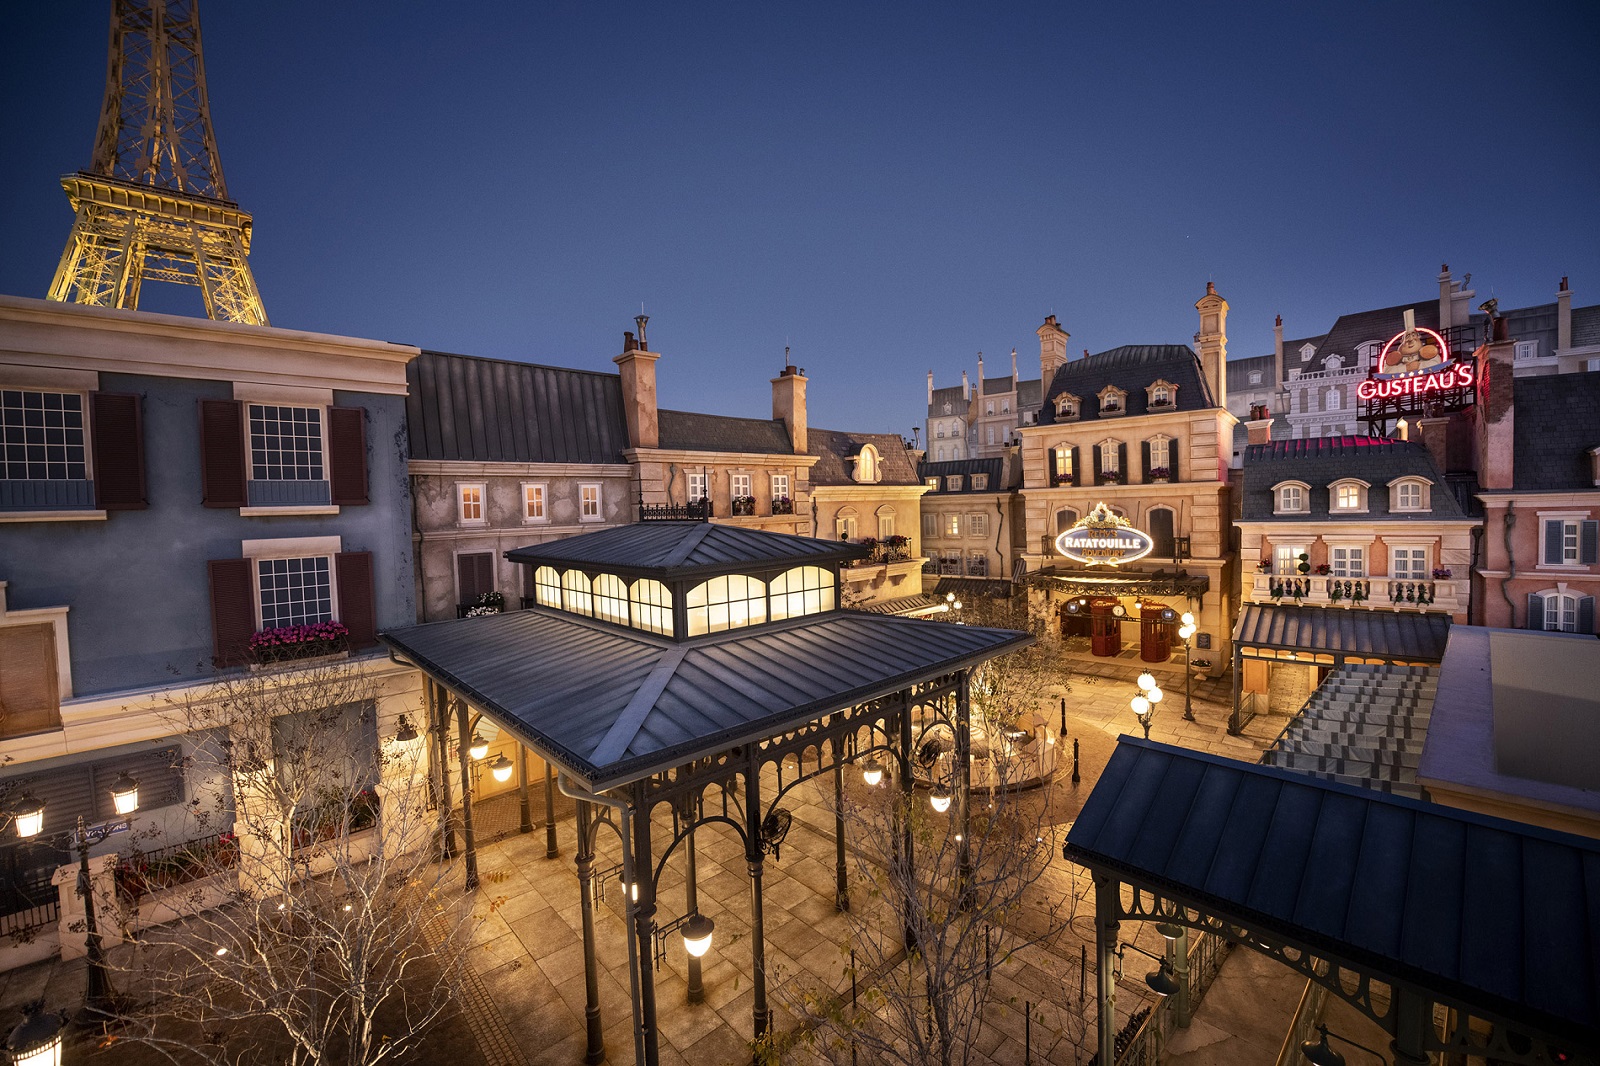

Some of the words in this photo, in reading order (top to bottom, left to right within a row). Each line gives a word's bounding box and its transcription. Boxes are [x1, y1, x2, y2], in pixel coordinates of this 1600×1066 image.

[1357, 364, 1473, 399] GUSTEAU'S
[1065, 537, 1141, 549] RATATOUILLE
[1081, 548, 1125, 557] ADVENTURE
